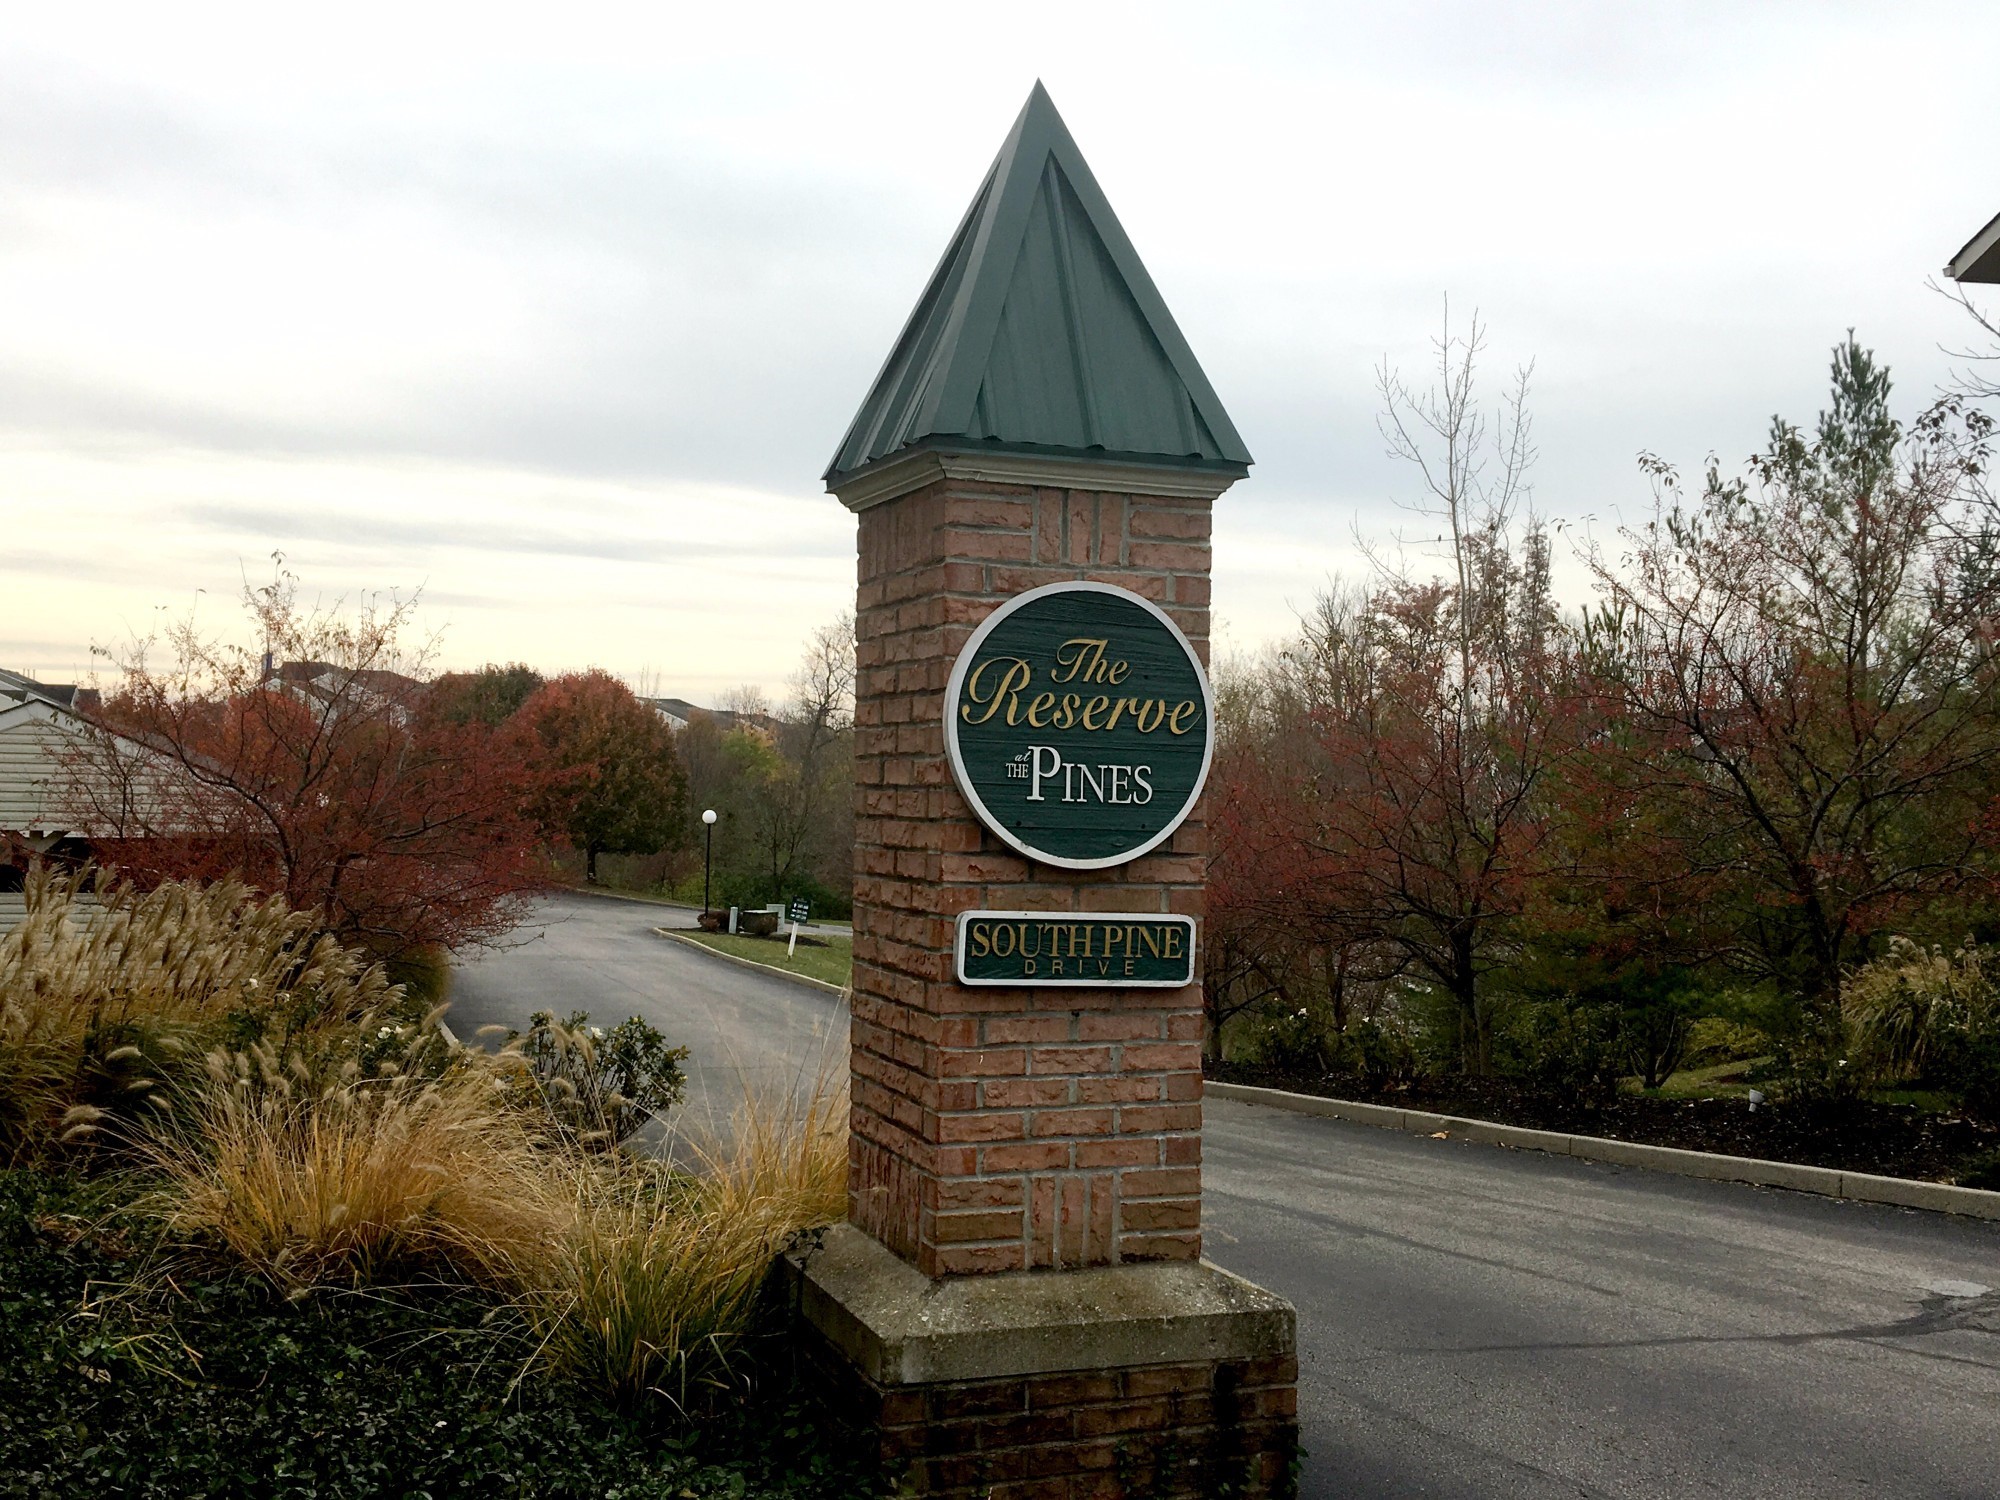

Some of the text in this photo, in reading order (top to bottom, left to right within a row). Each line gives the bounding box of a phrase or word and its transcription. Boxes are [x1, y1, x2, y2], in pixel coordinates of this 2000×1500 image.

[1051, 638, 1132, 685] The
[962, 656, 1203, 735] Reserve
[1005, 746, 1153, 805] THE PINES
[1014, 750, 1031, 762] at
[1025, 959, 1134, 976] DRIVE
